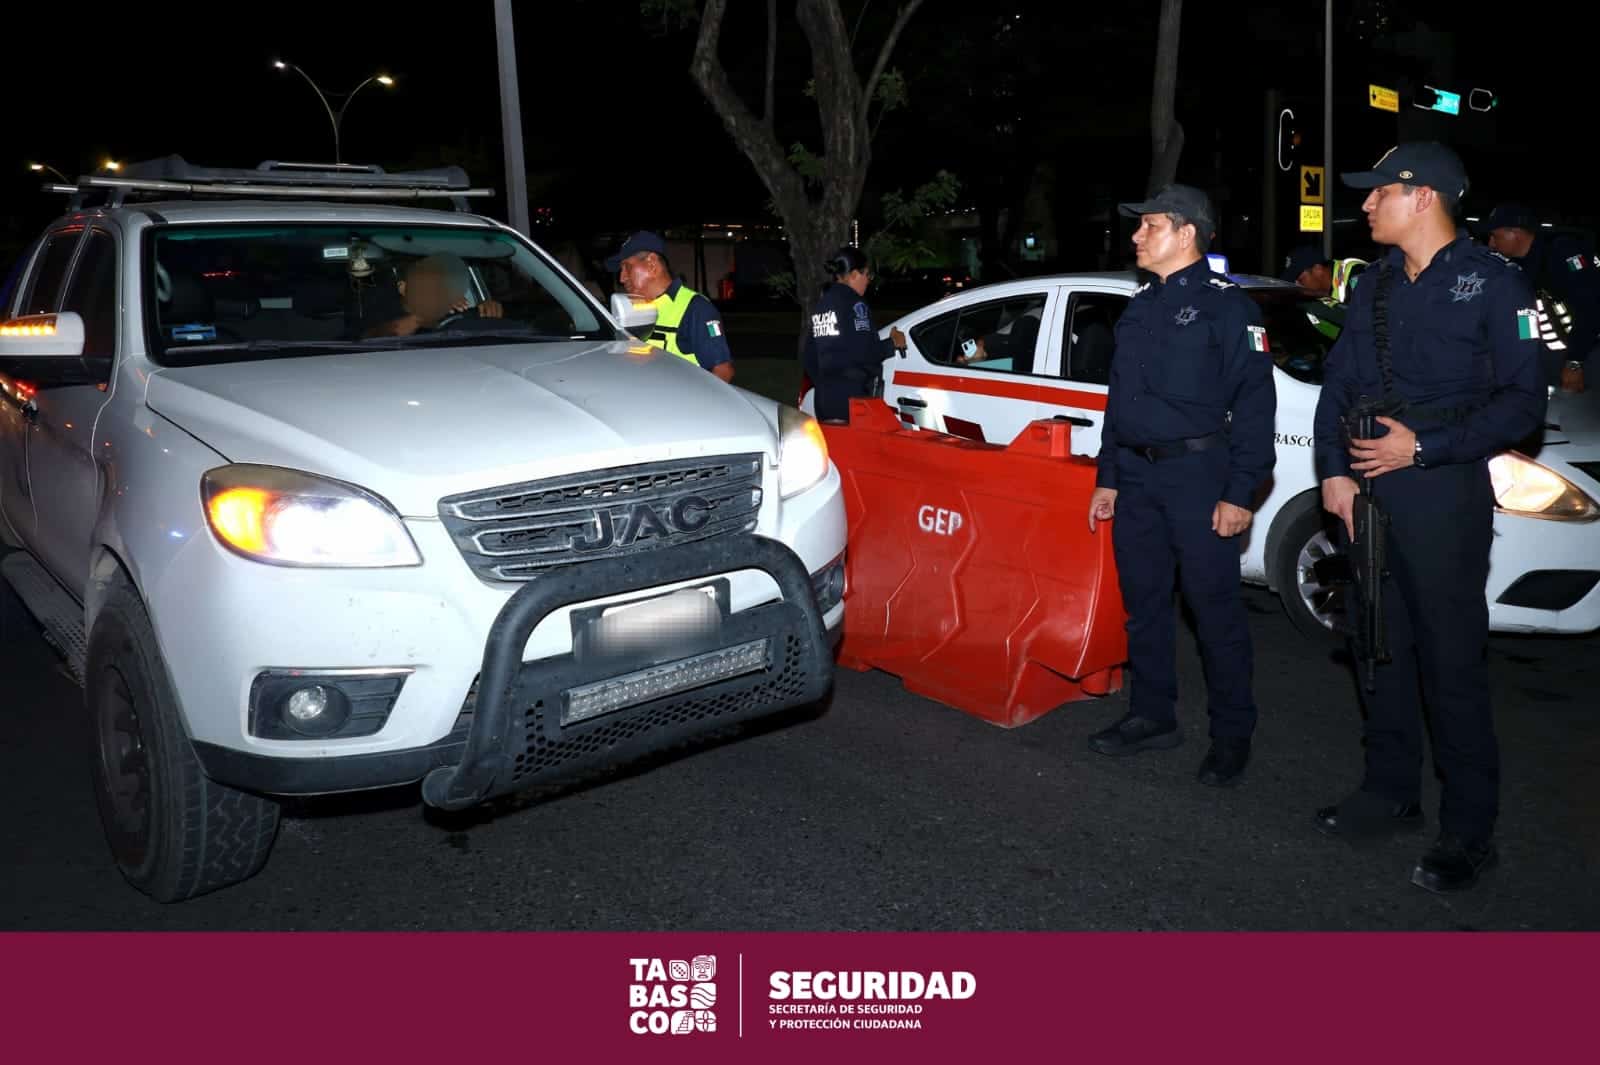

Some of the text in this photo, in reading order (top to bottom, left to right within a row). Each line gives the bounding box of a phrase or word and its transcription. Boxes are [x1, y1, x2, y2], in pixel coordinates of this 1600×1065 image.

[811, 309, 838, 326] OLICÍA
[812, 322, 840, 338] STATAL
[1273, 432, 1314, 448] BASC
[569, 495, 712, 553] JAC
[918, 504, 963, 535] GEP
